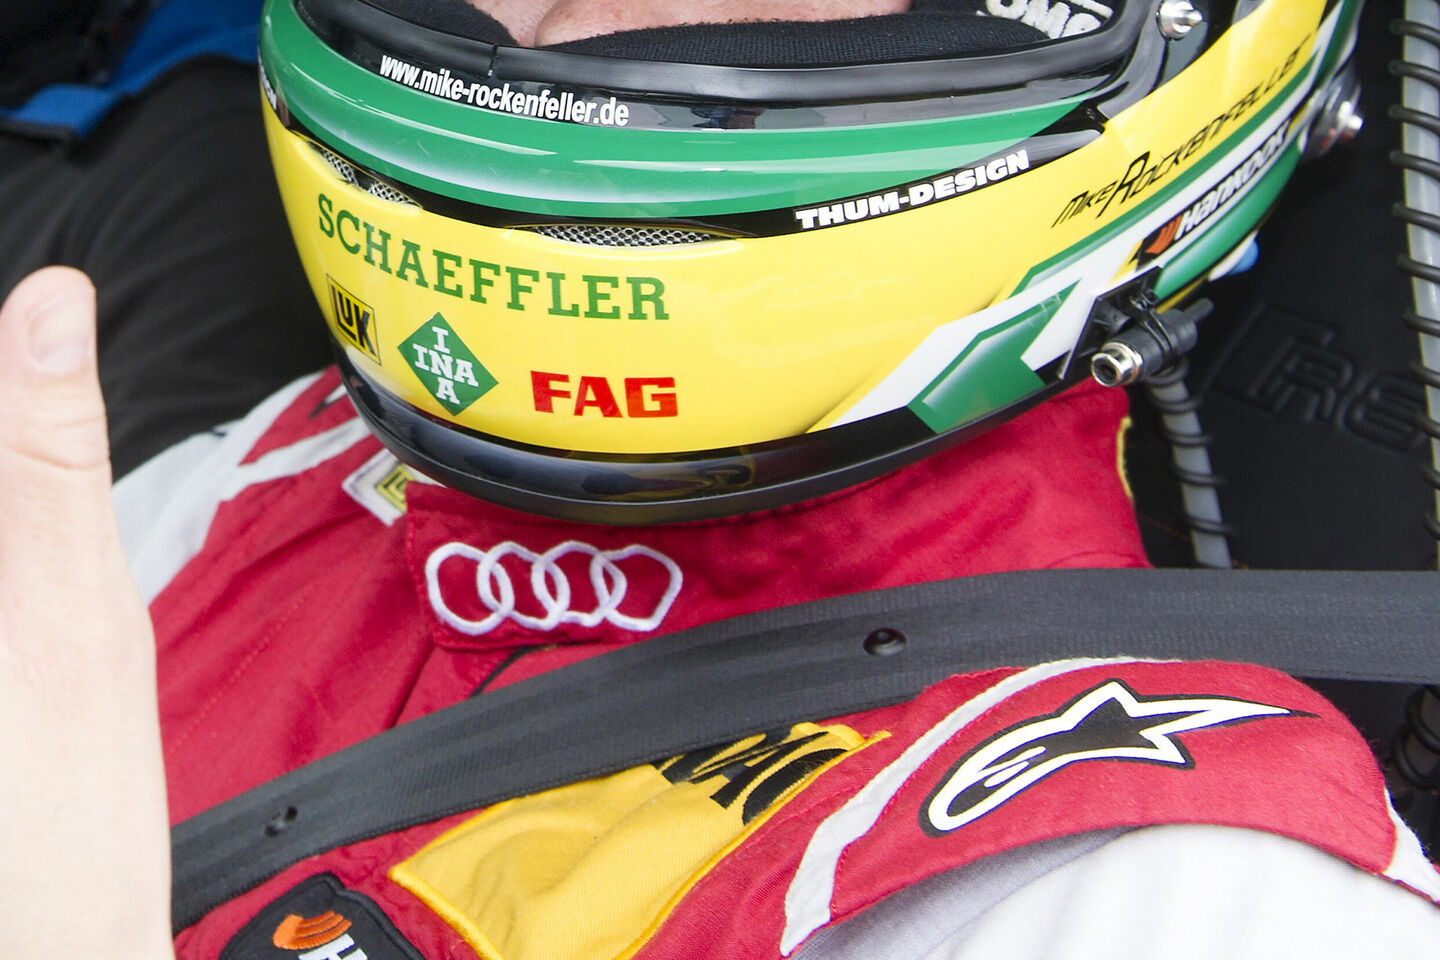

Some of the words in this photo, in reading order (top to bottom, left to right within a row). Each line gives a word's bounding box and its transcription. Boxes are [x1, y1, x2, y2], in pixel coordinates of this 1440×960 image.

[379, 54, 630, 127] www.mike-rockenfeller.de
[795, 149, 1031, 230] THUM-DESIGN
[318, 193, 670, 320] SCHAEFFLER
[530, 370, 679, 418] FAG
